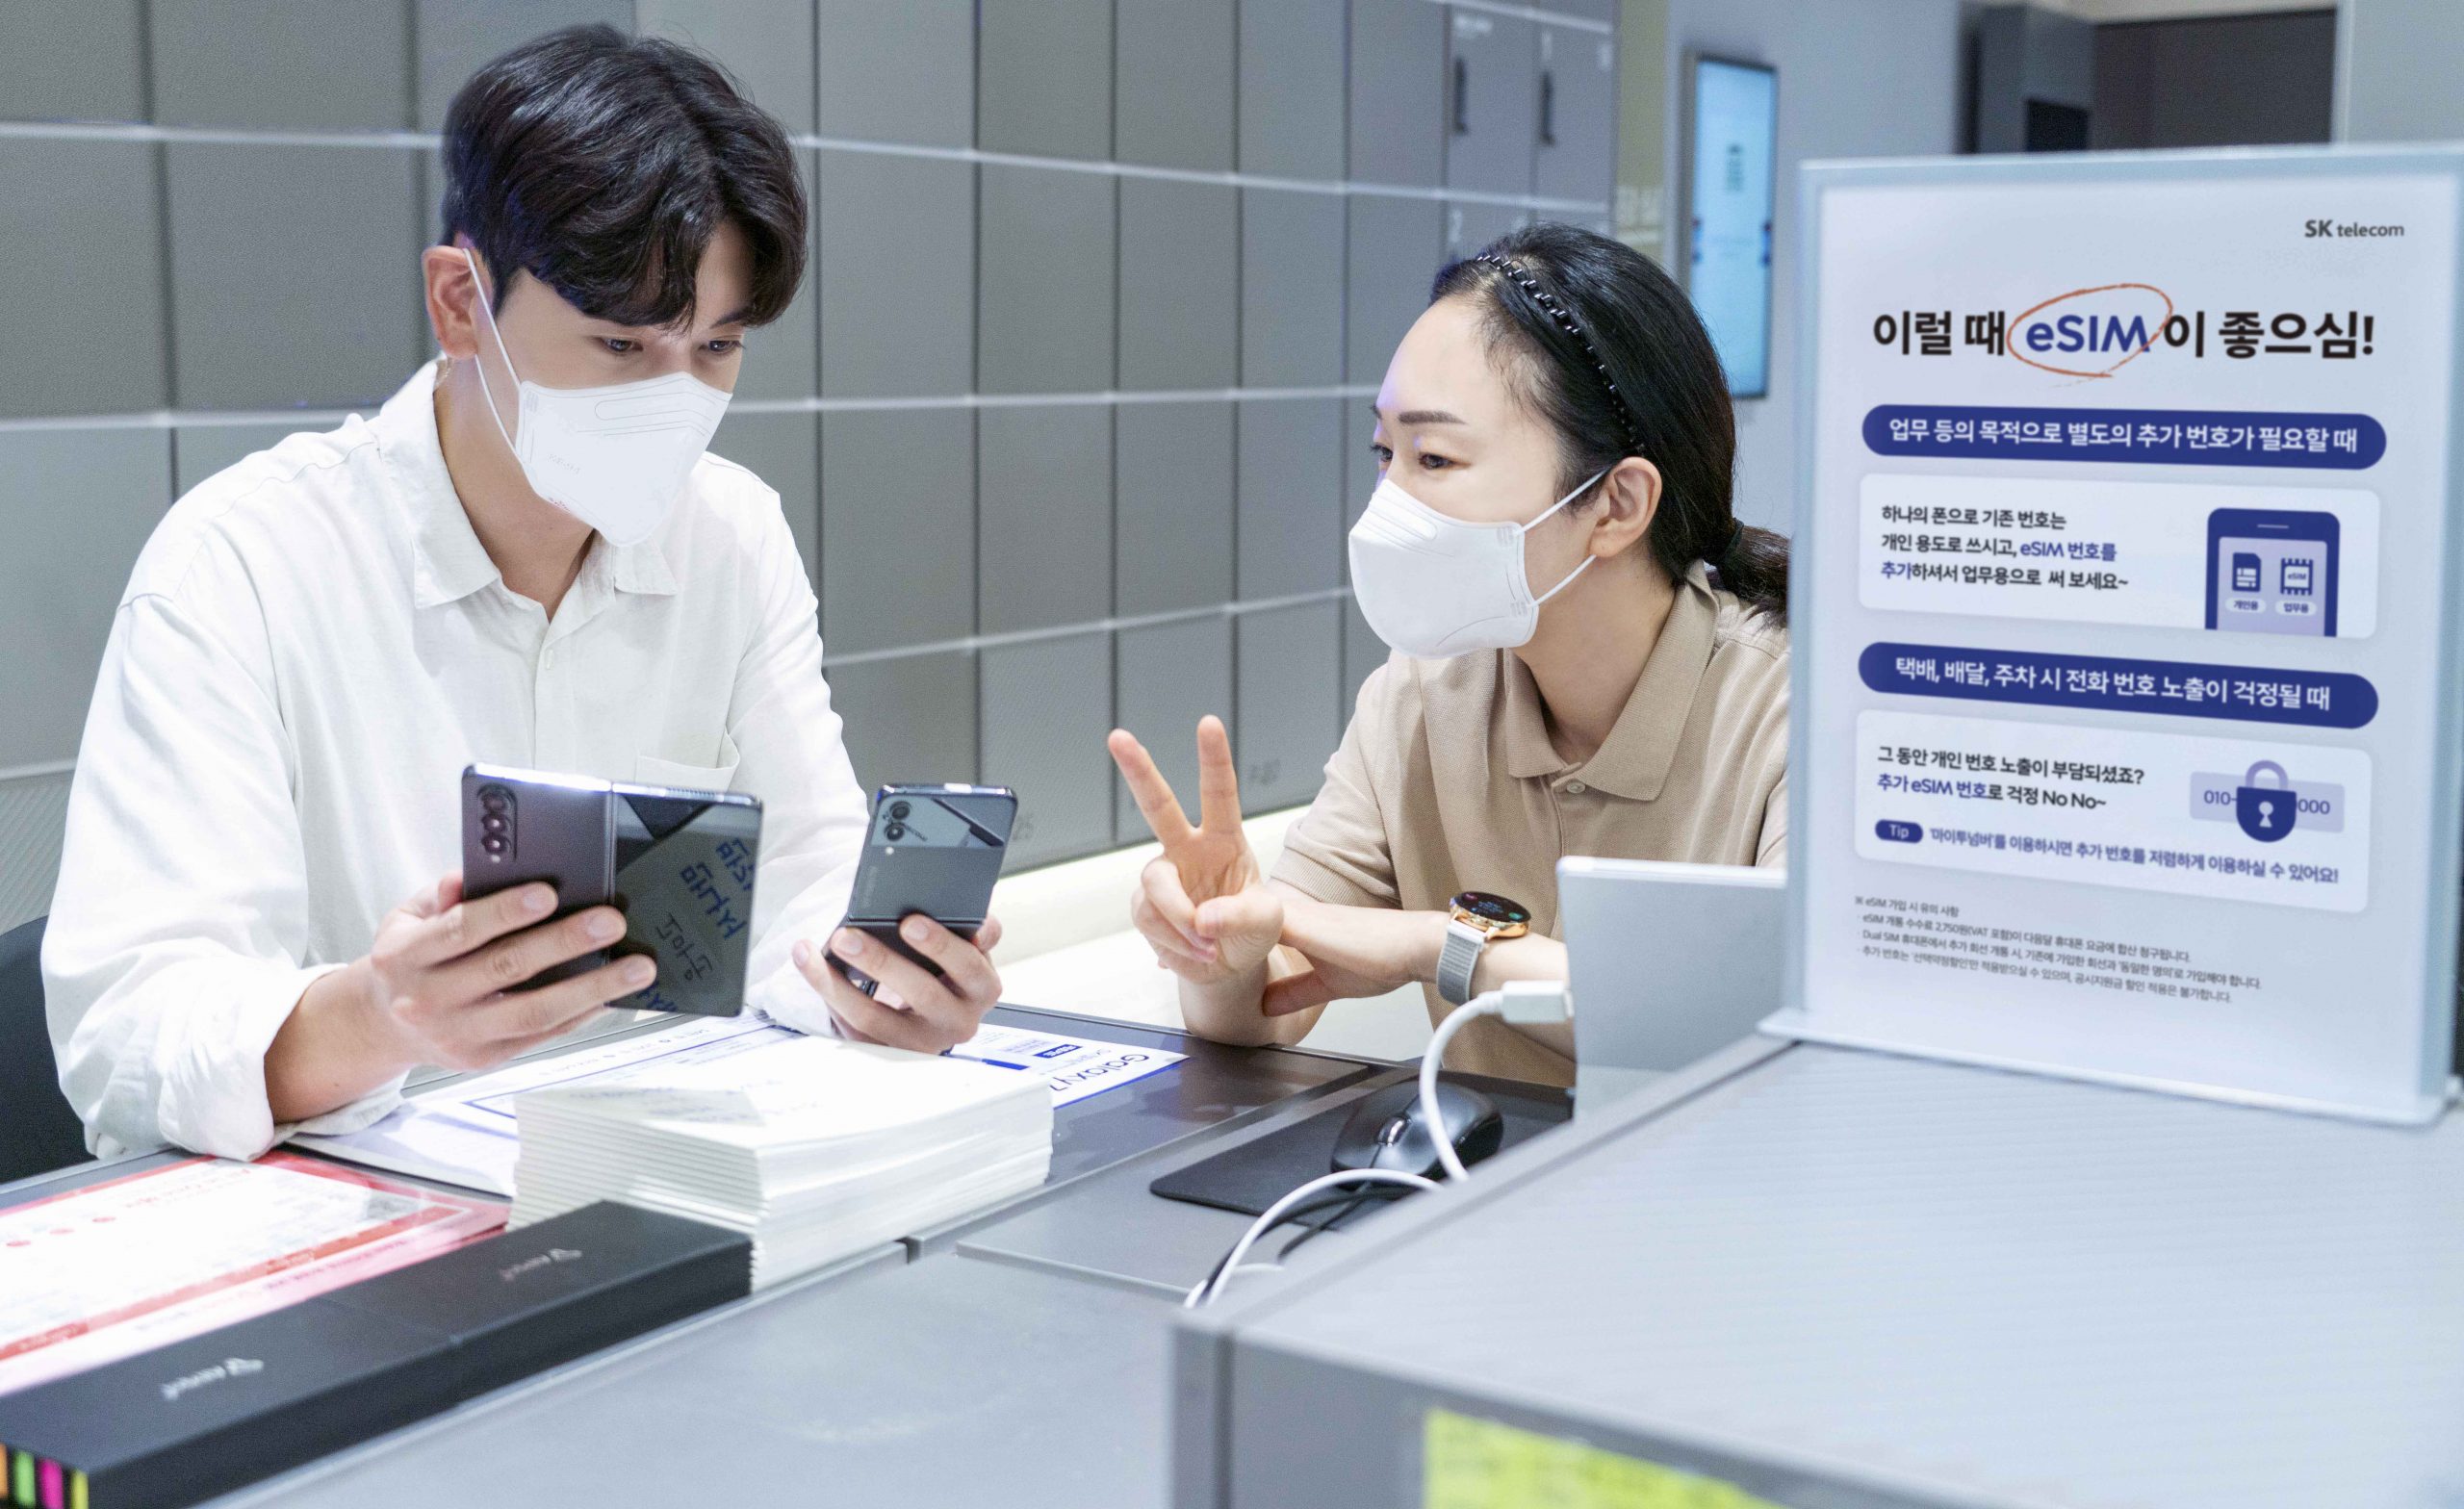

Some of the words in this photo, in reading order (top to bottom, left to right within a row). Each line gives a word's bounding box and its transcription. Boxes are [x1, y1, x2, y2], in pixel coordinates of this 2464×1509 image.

[2304, 218, 2333, 238] SK
[2336, 219, 2404, 238] telecom
[1873, 311, 1952, 355] 이럴
[1964, 311, 2007, 356] 때
[2025, 315, 2151, 353] eSIM
[2218, 312, 2374, 359] 좋으심!
[1889, 418, 1930, 442] 업무
[1934, 420, 1974, 444] 등의
[1979, 421, 2063, 445] 목적으로
[2068, 422, 2132, 448] 별도의
[2137, 423, 2182, 448] 추가
[2187, 425, 2254, 450] 번호가
[2259, 426, 2327, 452] 필요할
[2333, 428, 2357, 453] 때
[1882, 505, 1928, 524] 하나의
[1931, 507, 1979, 525] 폰으로
[1983, 509, 2014, 527] 기존
[2017, 511, 2066, 530] 번호는
[1882, 533, 1912, 551] 개인
[1915, 535, 1963, 553] 용도로
[1965, 538, 2017, 558] 쓰시고,
[2020, 541, 2065, 557] eSIM
[2067, 542, 2117, 561] 번호를
[1881, 562, 1958, 582] 추가하셔서
[1962, 566, 2041, 586] 업무용으로
[2048, 570, 2065, 588] 써
[2068, 572, 2128, 590] 보세요~
[2233, 600, 2259, 611] 개인용
[2283, 602, 2309, 613] 업무용
[1895, 657, 1940, 683] 택배,
[1944, 660, 1989, 687] 배달,
[1993, 664, 2036, 689] 주차
[2040, 668, 2061, 691] 시
[2066, 669, 2109, 694] 전화
[2114, 673, 2156, 696] 번호
[2161, 677, 2227, 703] 노출이
[2233, 680, 2301, 709] 걱정될
[2306, 685, 2330, 711] 때
[1878, 746, 1893, 762] 그
[1896, 748, 1928, 766] 동안
[1931, 751, 1962, 769] 개인
[1965, 754, 1996, 772] 번호
[1999, 757, 2048, 778] 노출이
[2051, 760, 2144, 784] 부담되셨죠?
[1878, 773, 1909, 792] 추가
[1911, 779, 1953, 796] eSIM
[1956, 781, 2003, 800] 번호로
[2007, 785, 2040, 806] 걱정
[2042, 790, 2067, 806] No
[2070, 793, 2106, 809] No~
[1888, 824, 1910, 838] Tip
[2009, 835, 2072, 857] 이용하시면
[2076, 842, 2102, 859] 추가
[2105, 845, 2145, 864] 번호를
[2148, 850, 2204, 871] 저렴하게
[2208, 856, 2266, 878] 이용하실
[2270, 862, 2285, 879] 수
[2289, 864, 2339, 883] 있어요!
[1865, 897, 1886, 908] eSIM
[1888, 900, 1907, 912] 가입
[1909, 902, 1918, 913] 시
[1920, 903, 1938, 914] 유의
[1940, 905, 1959, 917] 사항
[1862, 914, 1884, 925] eSIM
[2055, 935, 2084, 950] 휴대폰
[2086, 939, 2115, 954] 요금에
[1862, 930, 1882, 940] Dual
[1884, 932, 1900, 942] SIM
[1949, 938, 1967, 952] 추가
[1053, 1054, 1149, 1087] Galaxy
